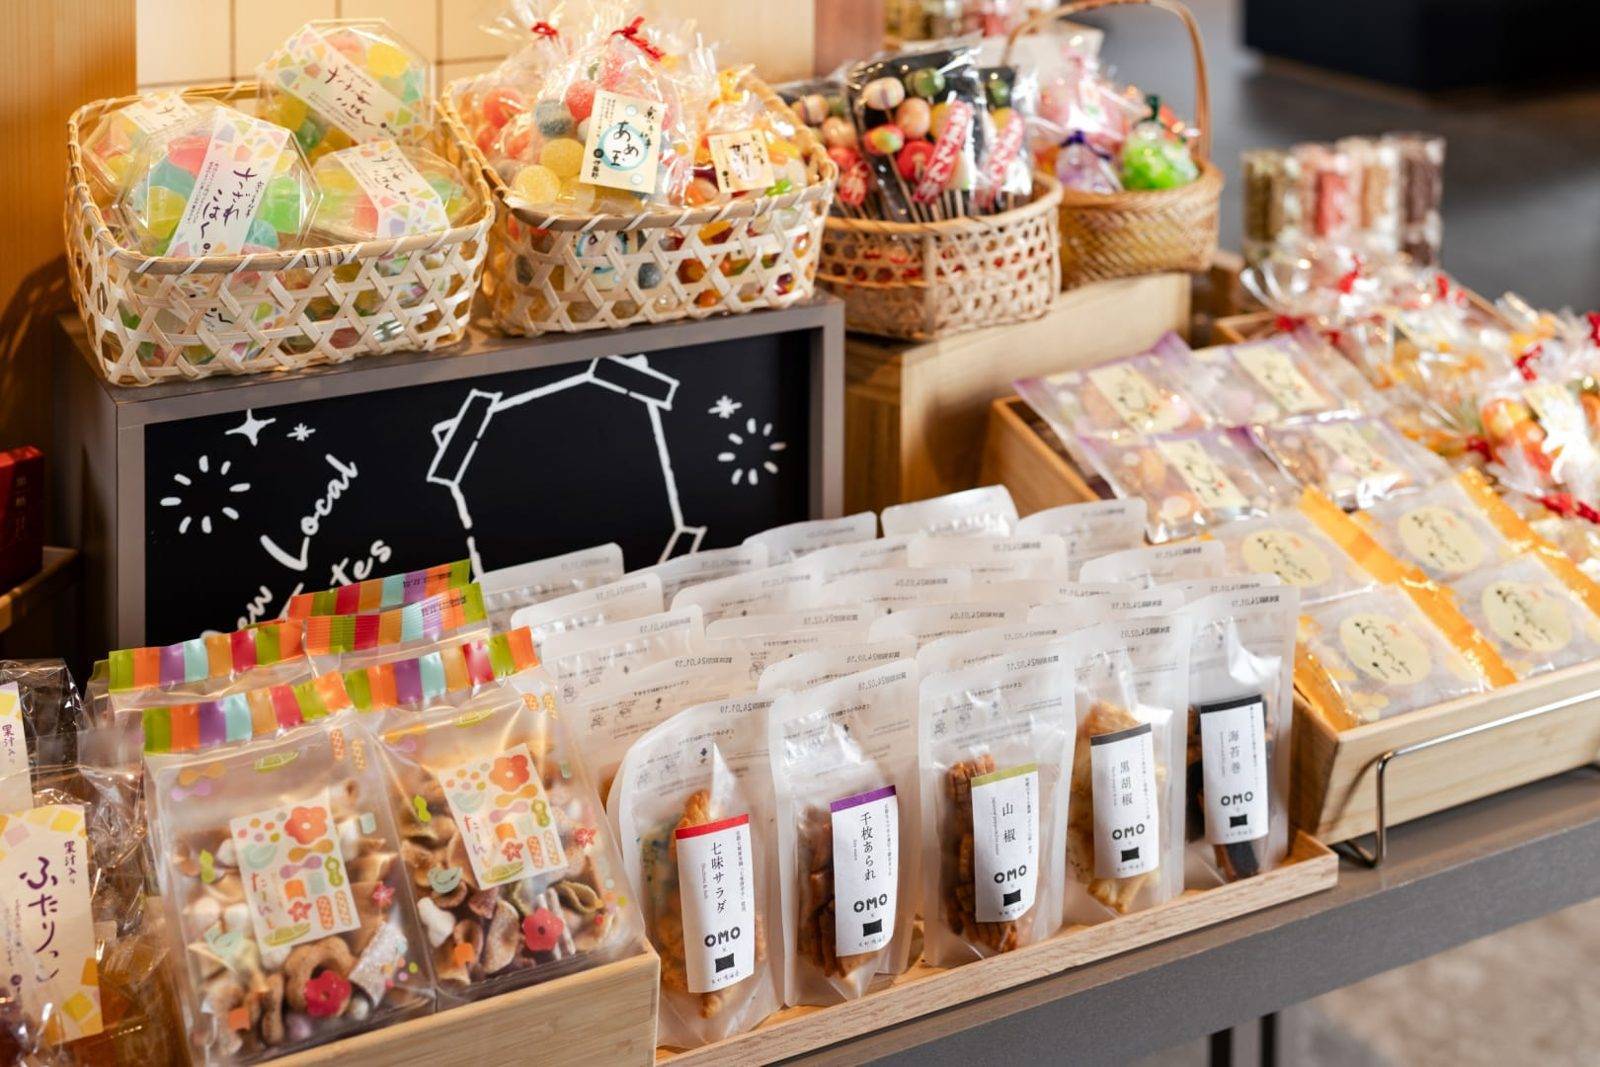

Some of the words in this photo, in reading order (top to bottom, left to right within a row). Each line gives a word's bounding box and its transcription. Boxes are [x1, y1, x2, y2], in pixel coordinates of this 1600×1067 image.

[259, 453, 358, 571] Local
[1119, 759, 1133, 807] 黒胡椒
[1220, 791, 1254, 807] OMO
[1002, 801, 1016, 843] 山椒
[1112, 822, 1146, 841] OMO
[859, 811, 876, 881] 千枚あられ
[710, 841, 727, 915] 七味サラダ
[993, 864, 1027, 884] OMO
[853, 893, 888, 914] OMO
[704, 926, 741, 948] OMO
